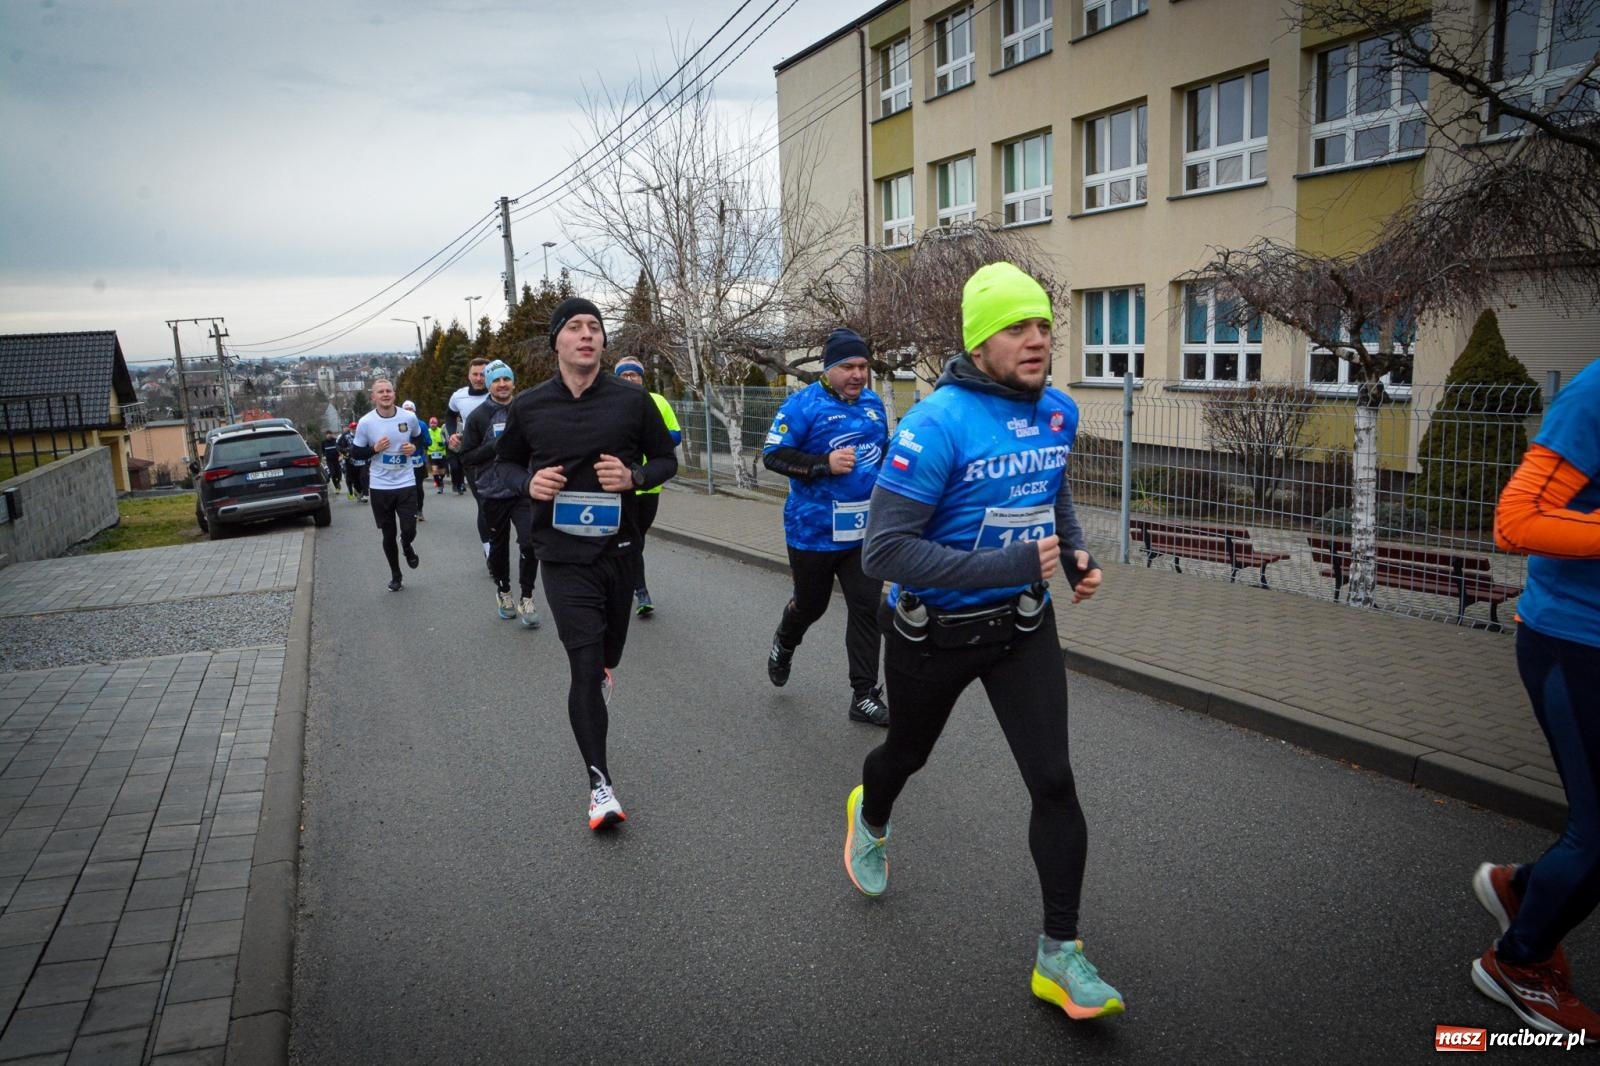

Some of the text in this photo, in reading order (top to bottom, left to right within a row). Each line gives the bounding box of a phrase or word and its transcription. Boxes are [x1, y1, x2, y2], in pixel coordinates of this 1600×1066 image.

[1008, 480, 1049, 500] JACEK
[579, 505, 595, 524] 6
[854, 512, 865, 529] 3
